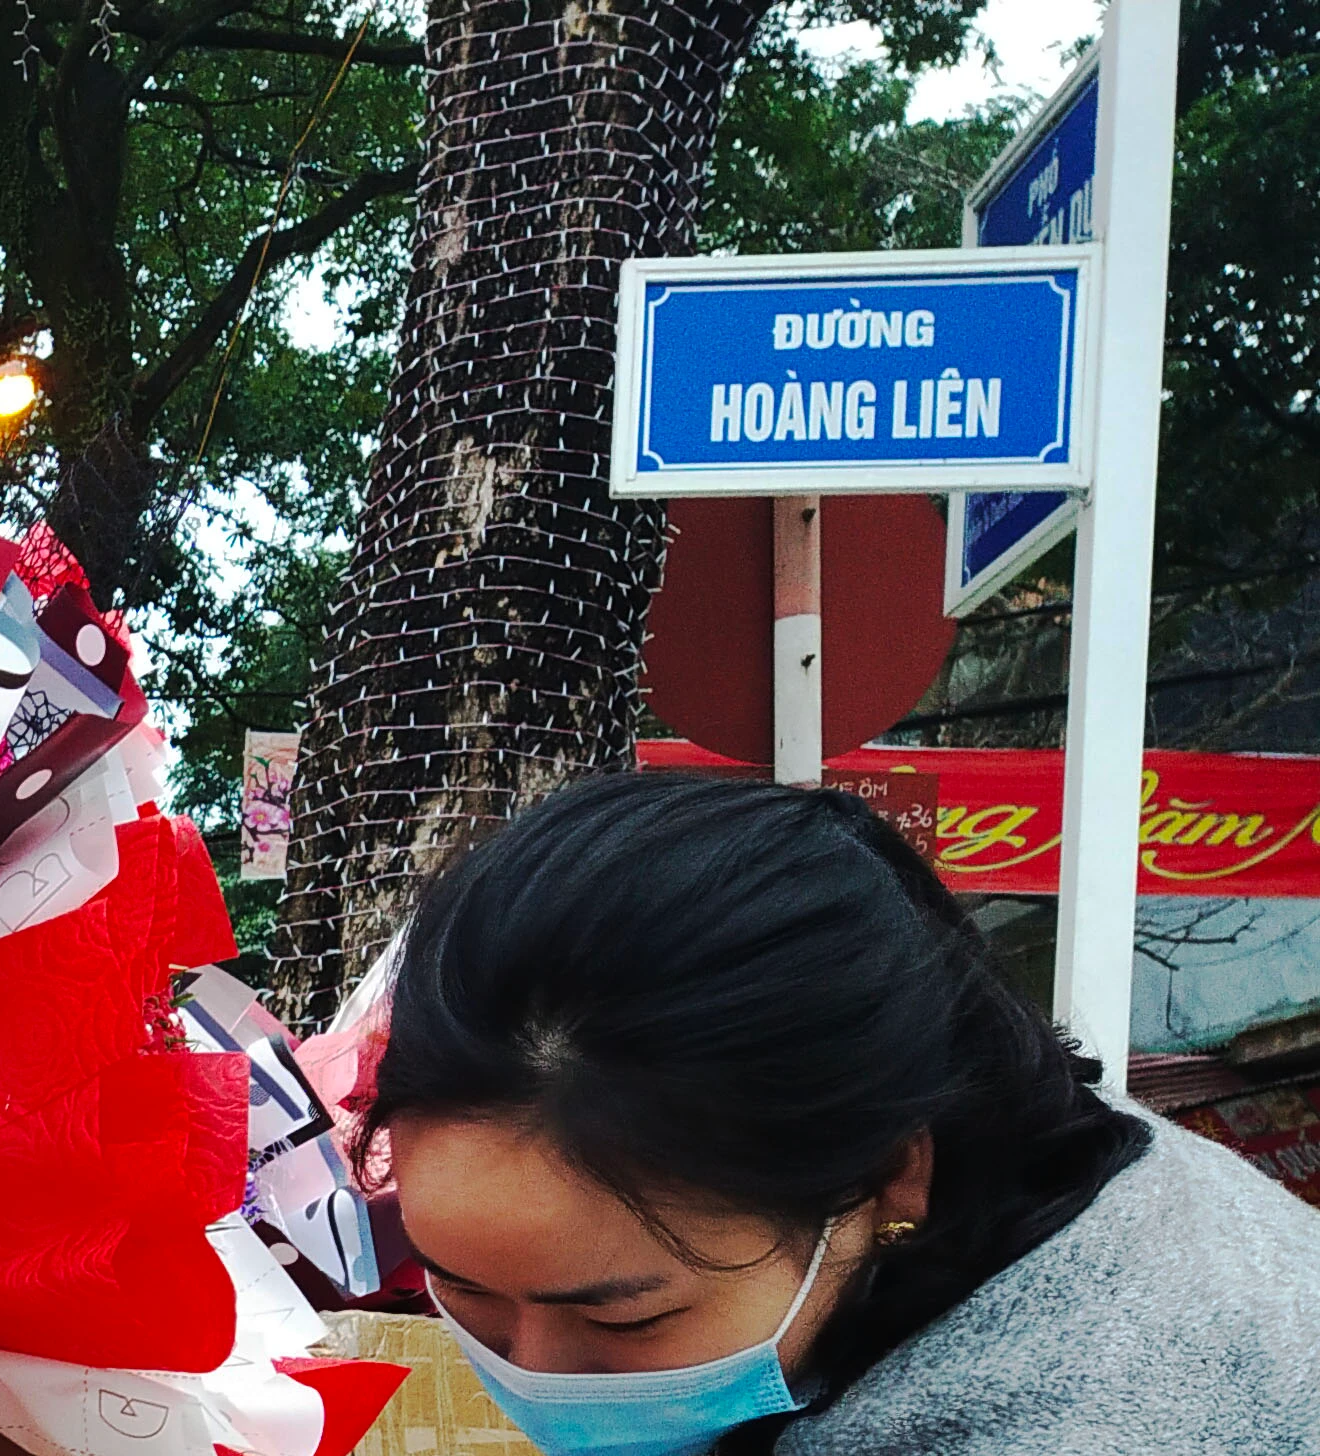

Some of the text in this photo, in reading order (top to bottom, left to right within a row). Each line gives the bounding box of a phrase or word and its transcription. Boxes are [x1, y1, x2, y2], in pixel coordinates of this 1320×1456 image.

[772, 298, 936, 350] ĐƯỜNG
[710, 368, 1002, 442] HOÀNG LIÊN
